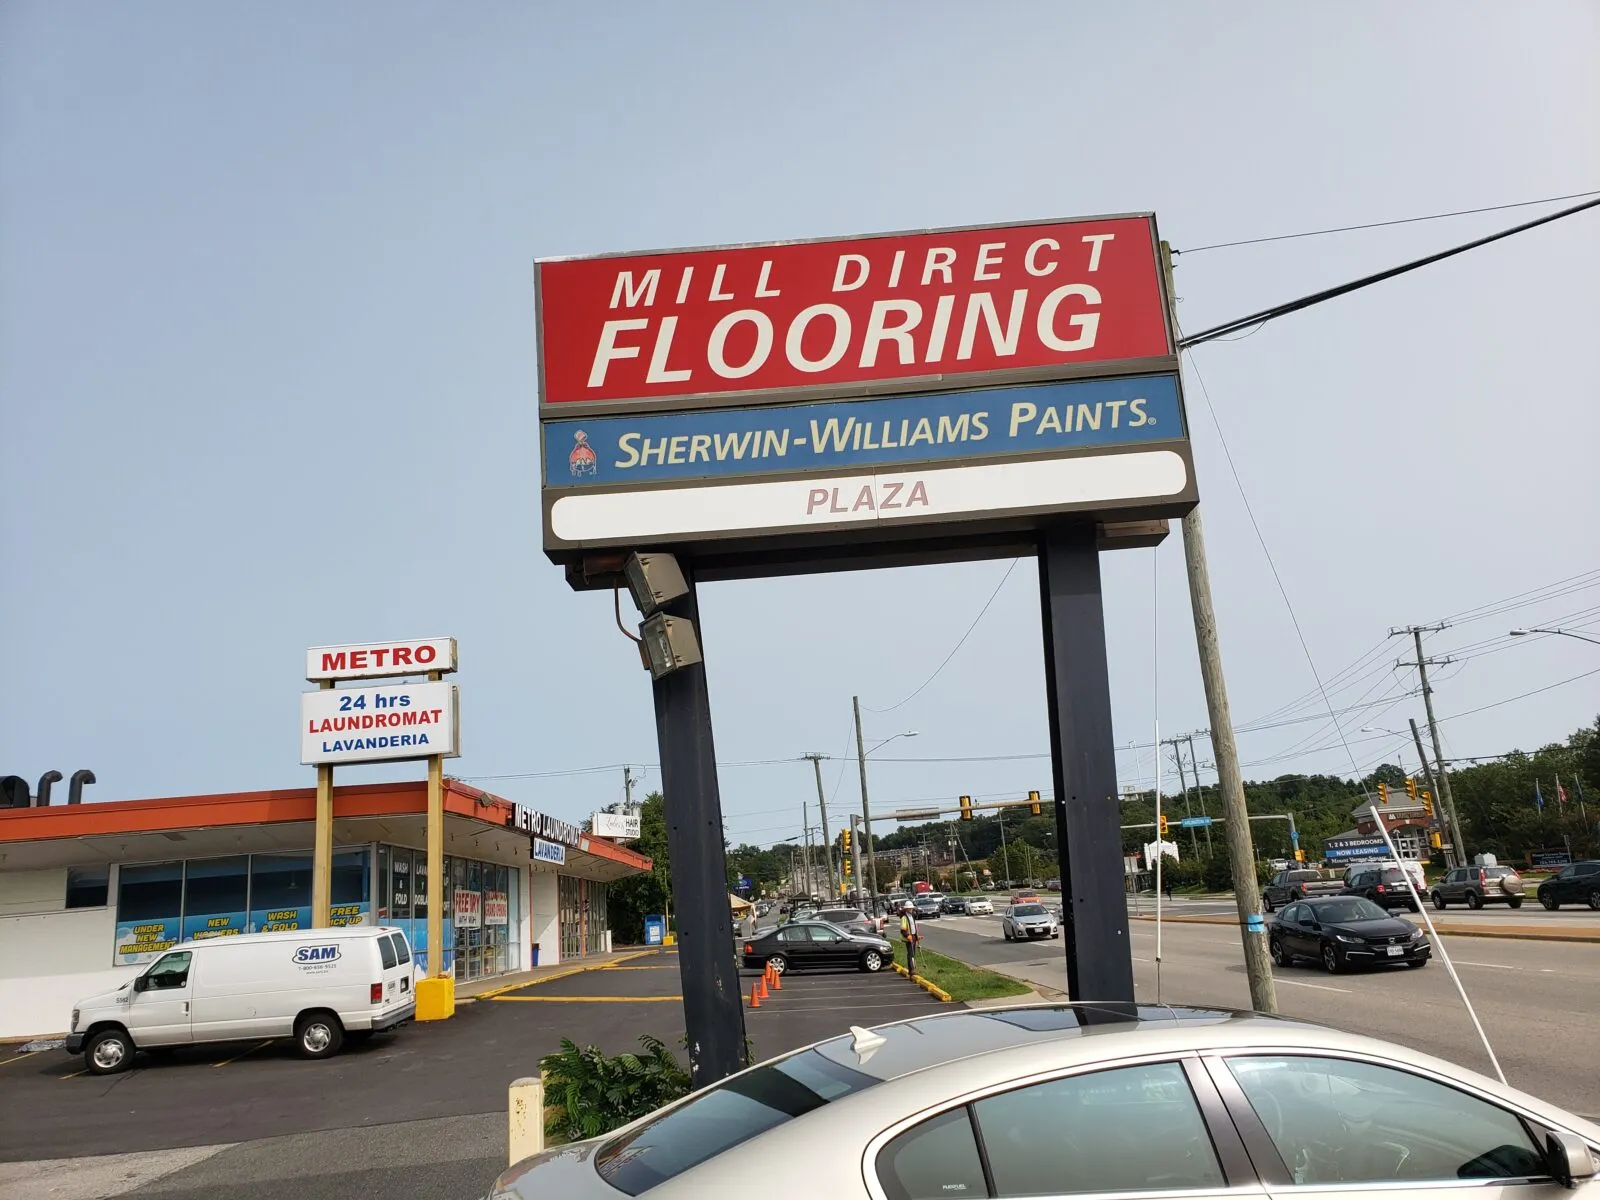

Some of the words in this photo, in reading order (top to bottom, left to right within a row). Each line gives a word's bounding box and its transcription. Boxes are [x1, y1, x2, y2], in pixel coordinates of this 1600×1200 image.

[609, 260, 781, 309] MILL
[831, 233, 1115, 293] DIRECT
[586, 283, 1103, 388] FLOORING
[614, 411, 989, 468] SHERWIN-WILLIAMS
[806, 480, 929, 515] PLAZA
[321, 645, 437, 671] METRO
[339, 695, 367, 712] 24
[375, 694, 411, 709] hrs
[309, 709, 443, 734] LAUNDROMAT
[322, 733, 430, 753] LAVANDERIA
[515, 803, 541, 834] METRO
[542, 815, 581, 847] LAUNDROMAT
[625, 818, 639, 828] HAIR
[625, 828, 640, 837] STUDIO
[1349, 838, 1384, 847] BEDROOMS
[534, 838, 564, 862] LAVANDERIA
[1352, 848, 1379, 856] LEASING
[394, 862, 408, 873] WASH
[395, 893, 407, 905] FOLD
[456, 892, 469, 913] FREE
[267, 910, 297, 921] WASH
[331, 905, 360, 916] FREE
[207, 917, 230, 927] NEW
[330, 917, 345, 926] ICK
[349, 916, 363, 925] UP
[133, 924, 164, 934] UNDER
[261, 925, 269, 933] &
[272, 922, 298, 932] FOLD
[136, 933, 158, 943] NEW
[193, 928, 239, 940] WERS
[119, 941, 176, 954] MANAGEMENT
[298, 947, 336, 961] SAM
